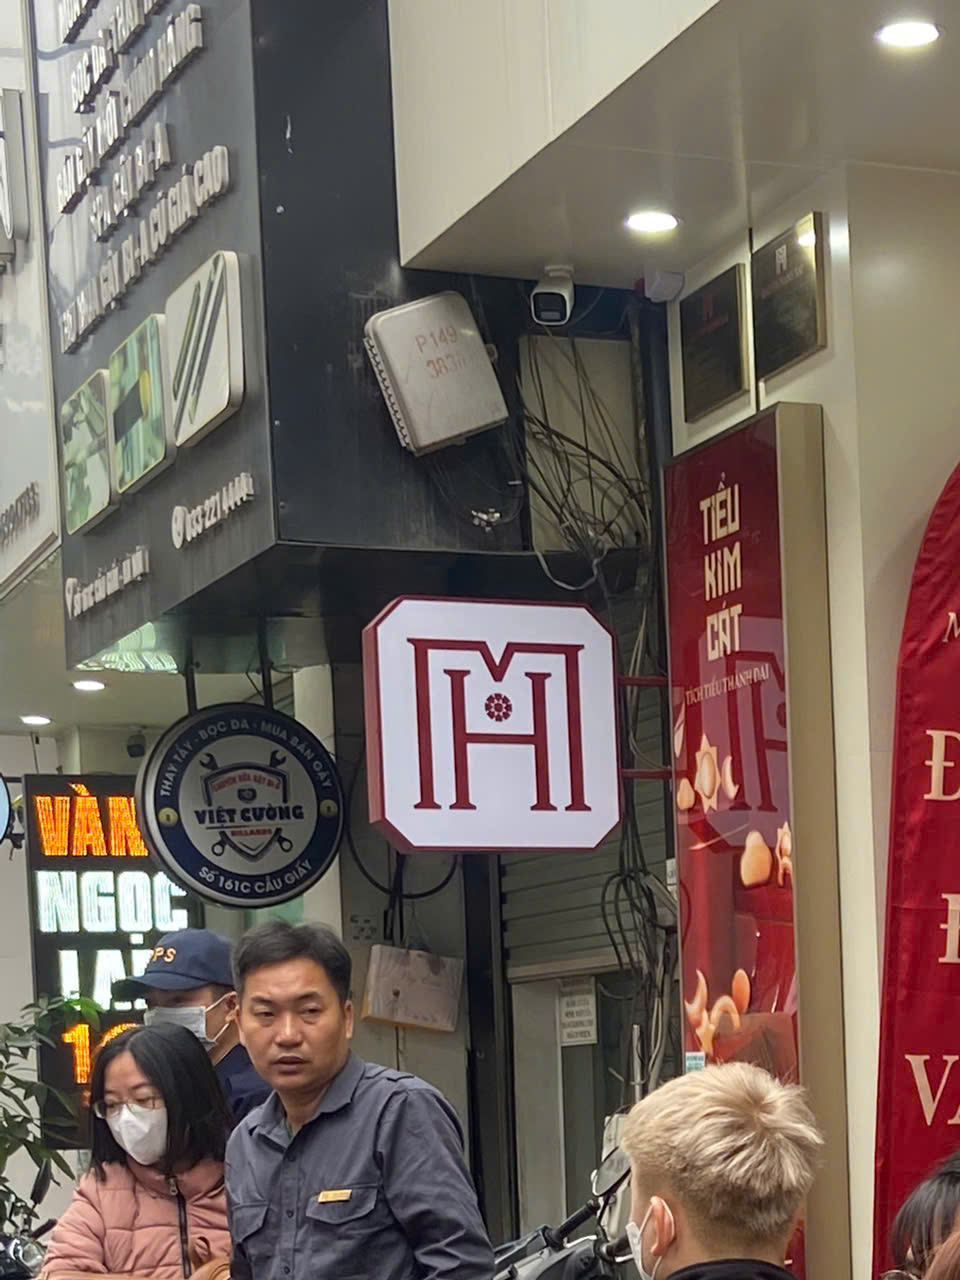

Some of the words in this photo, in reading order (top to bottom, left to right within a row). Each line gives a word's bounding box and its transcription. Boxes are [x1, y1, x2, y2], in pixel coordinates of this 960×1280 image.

[699, 472, 740, 545] TIỂU
[704, 541, 742, 601] KIM
[706, 600, 743, 662] CÁT
[160, 763, 179, 798] THAY
[198, 720, 227, 742] BỌC
[260, 720, 289, 741] MUA
[35, 783, 149, 857] VÀN
[36, 870, 188, 945] NGỌC
[218, 875, 251, 893] 161C
